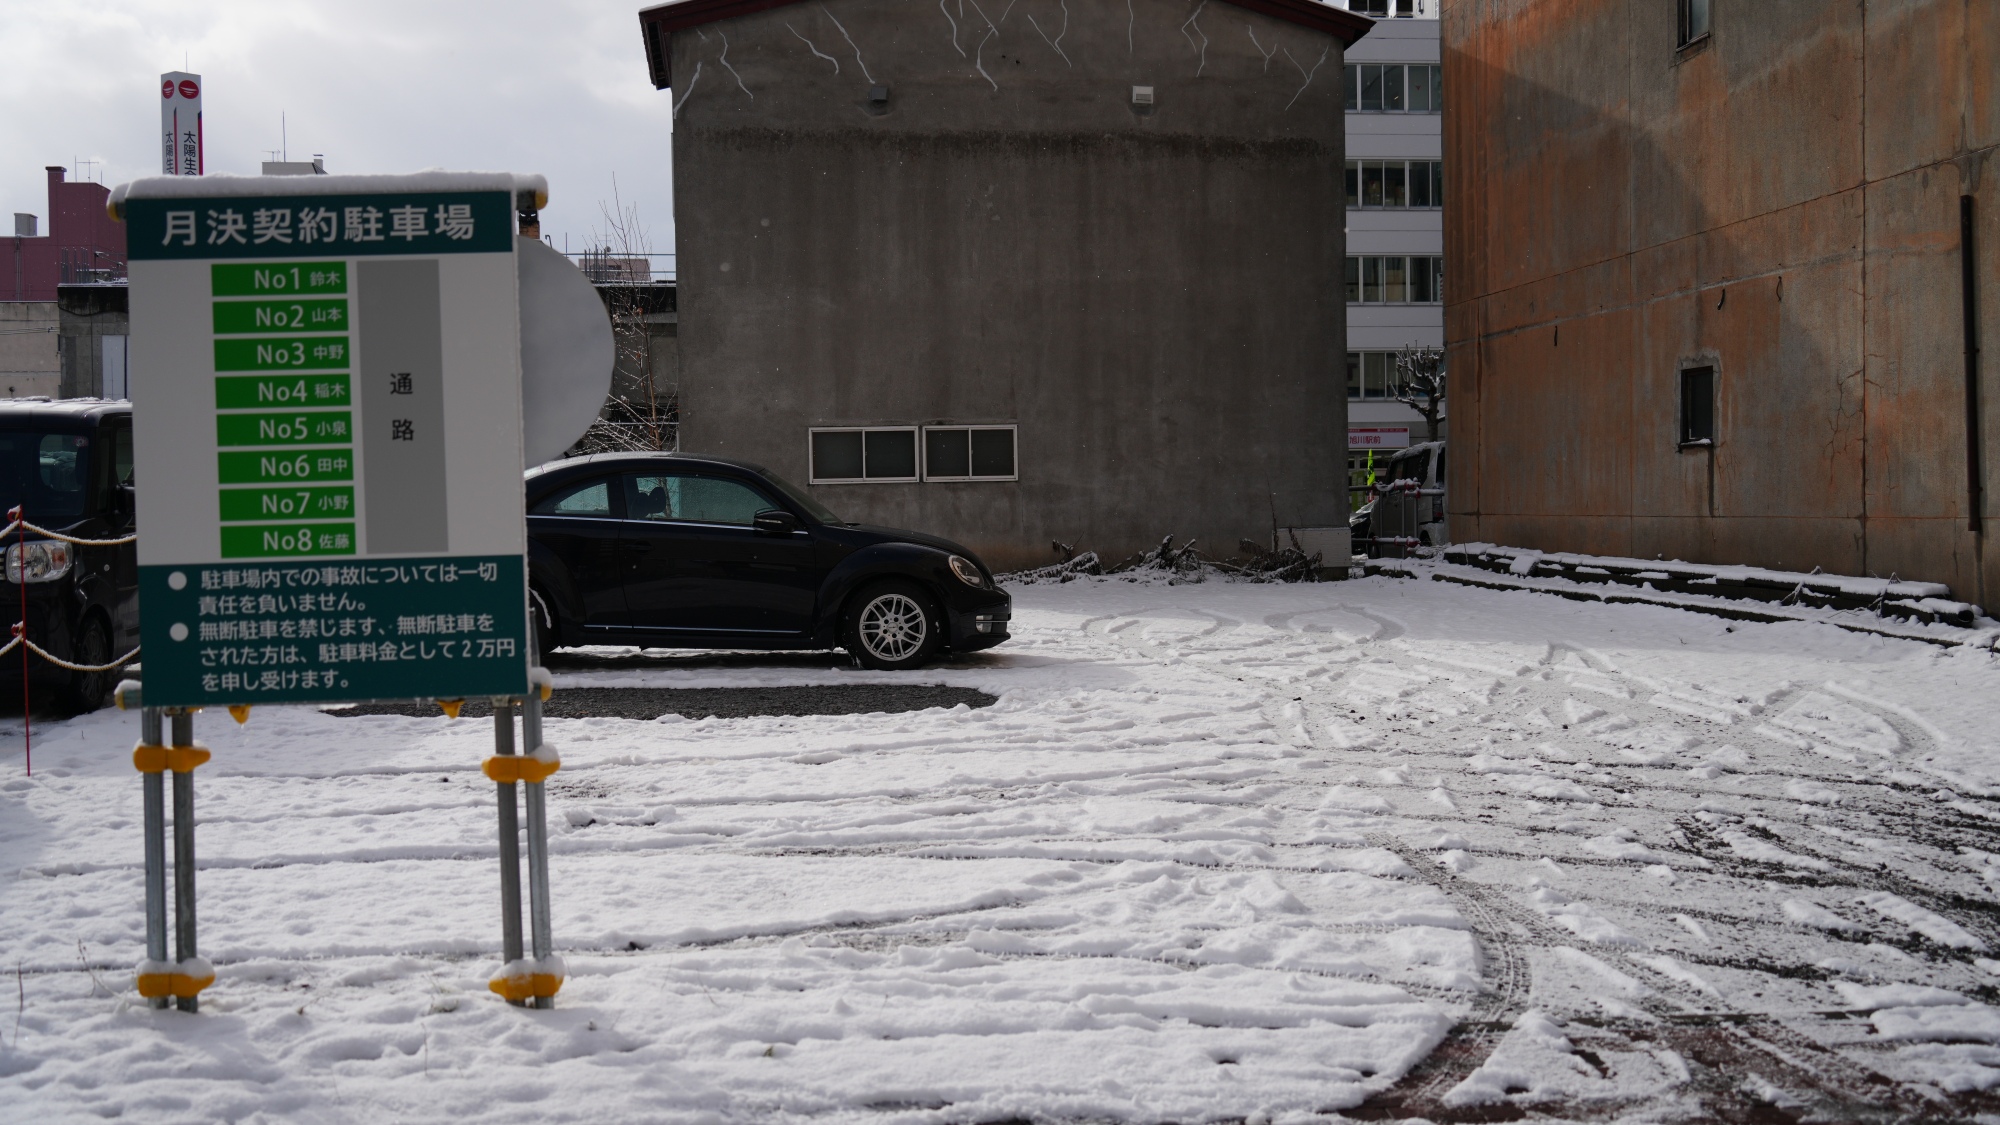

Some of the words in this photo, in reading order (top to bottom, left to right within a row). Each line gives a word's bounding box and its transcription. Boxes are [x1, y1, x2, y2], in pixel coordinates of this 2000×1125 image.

[161, 203, 475, 246] 月決契約駐車場
[255, 268, 299, 289] No1
[310, 272, 340, 286] 鈴木
[256, 305, 304, 327] No2
[312, 308, 342, 322] 山本
[258, 342, 305, 365] No3
[314, 345, 344, 359] 中野
[259, 380, 307, 402] No4
[315, 383, 344, 398] 稲木
[390, 373, 414, 441] 通路
[260, 417, 307, 439] No5
[316, 421, 346, 436] 小泉
[1349, 436, 1381, 444] 旭川駅前
[261, 455, 310, 477] No6
[318, 458, 347, 472] 田中
[263, 492, 310, 514] No7
[319, 495, 348, 510] 小野
[264, 529, 312, 551] No8
[319, 534, 349, 548] 佐藤
[201, 562, 497, 589] 駐車場内での事故については一切
[199, 591, 366, 616] 責任を負いません。
[199, 613, 494, 641] 無断駐車を禁じます、無断駐車を
[200, 638, 515, 666] された方は、駐車料金として2万円
[201, 669, 350, 692] を申し受けます。
